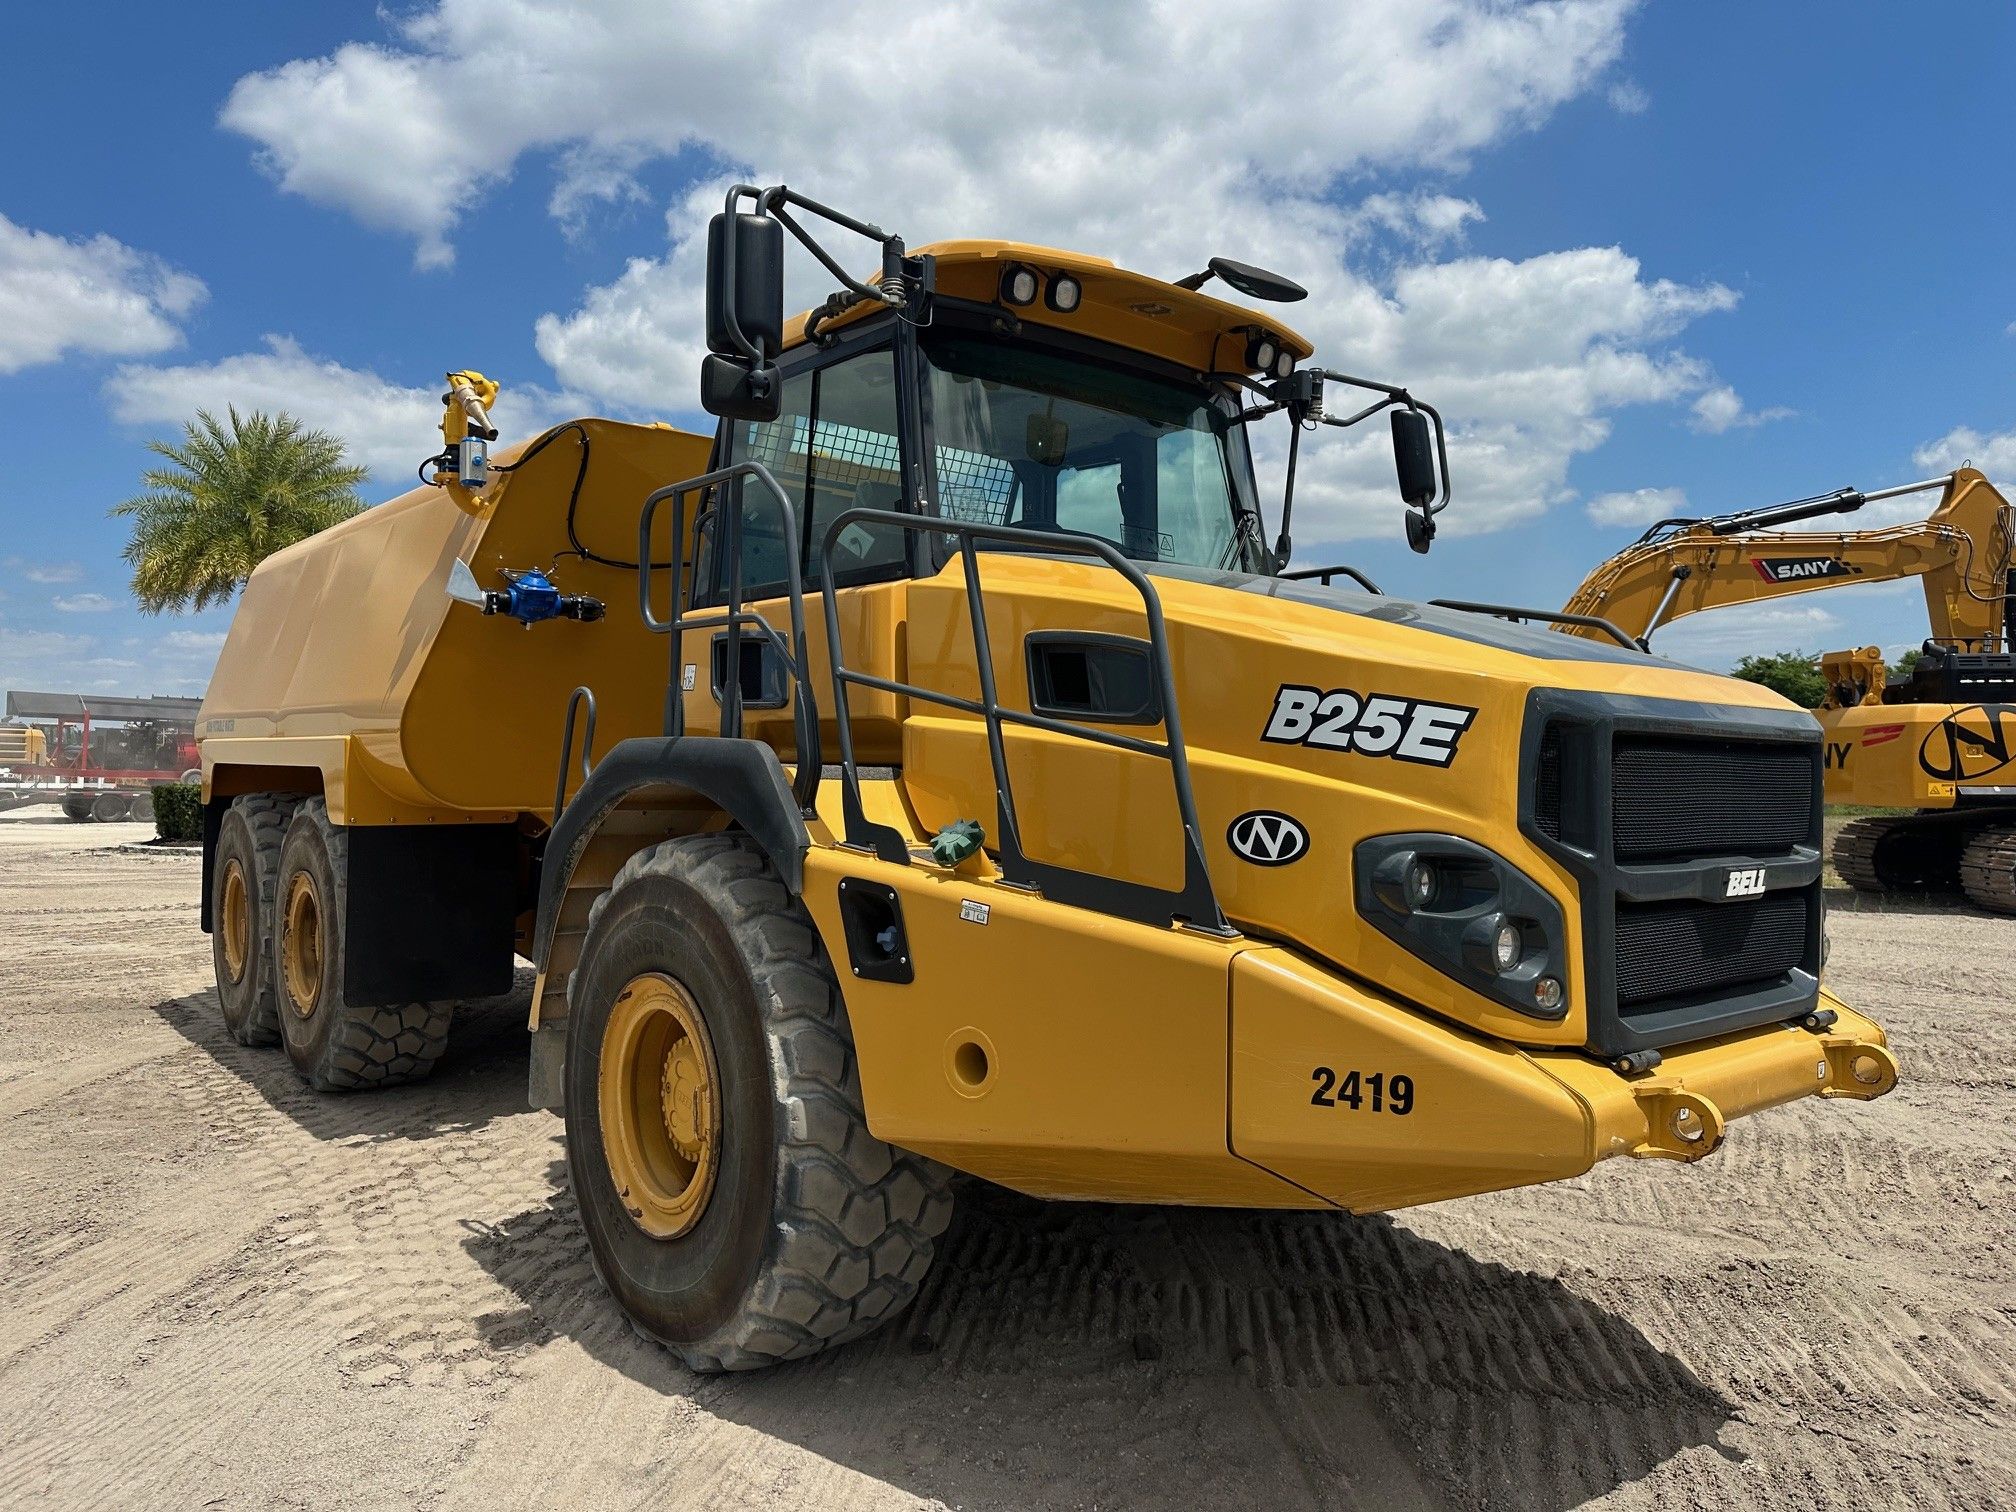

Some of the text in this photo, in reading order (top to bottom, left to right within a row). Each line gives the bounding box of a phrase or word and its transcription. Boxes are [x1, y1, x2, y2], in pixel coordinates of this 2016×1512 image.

[1777, 560, 1831, 579] SANY
[1263, 686, 1475, 765] B25E
[1726, 869, 1766, 897] BELL
[1310, 1066, 1415, 1116] 2419
